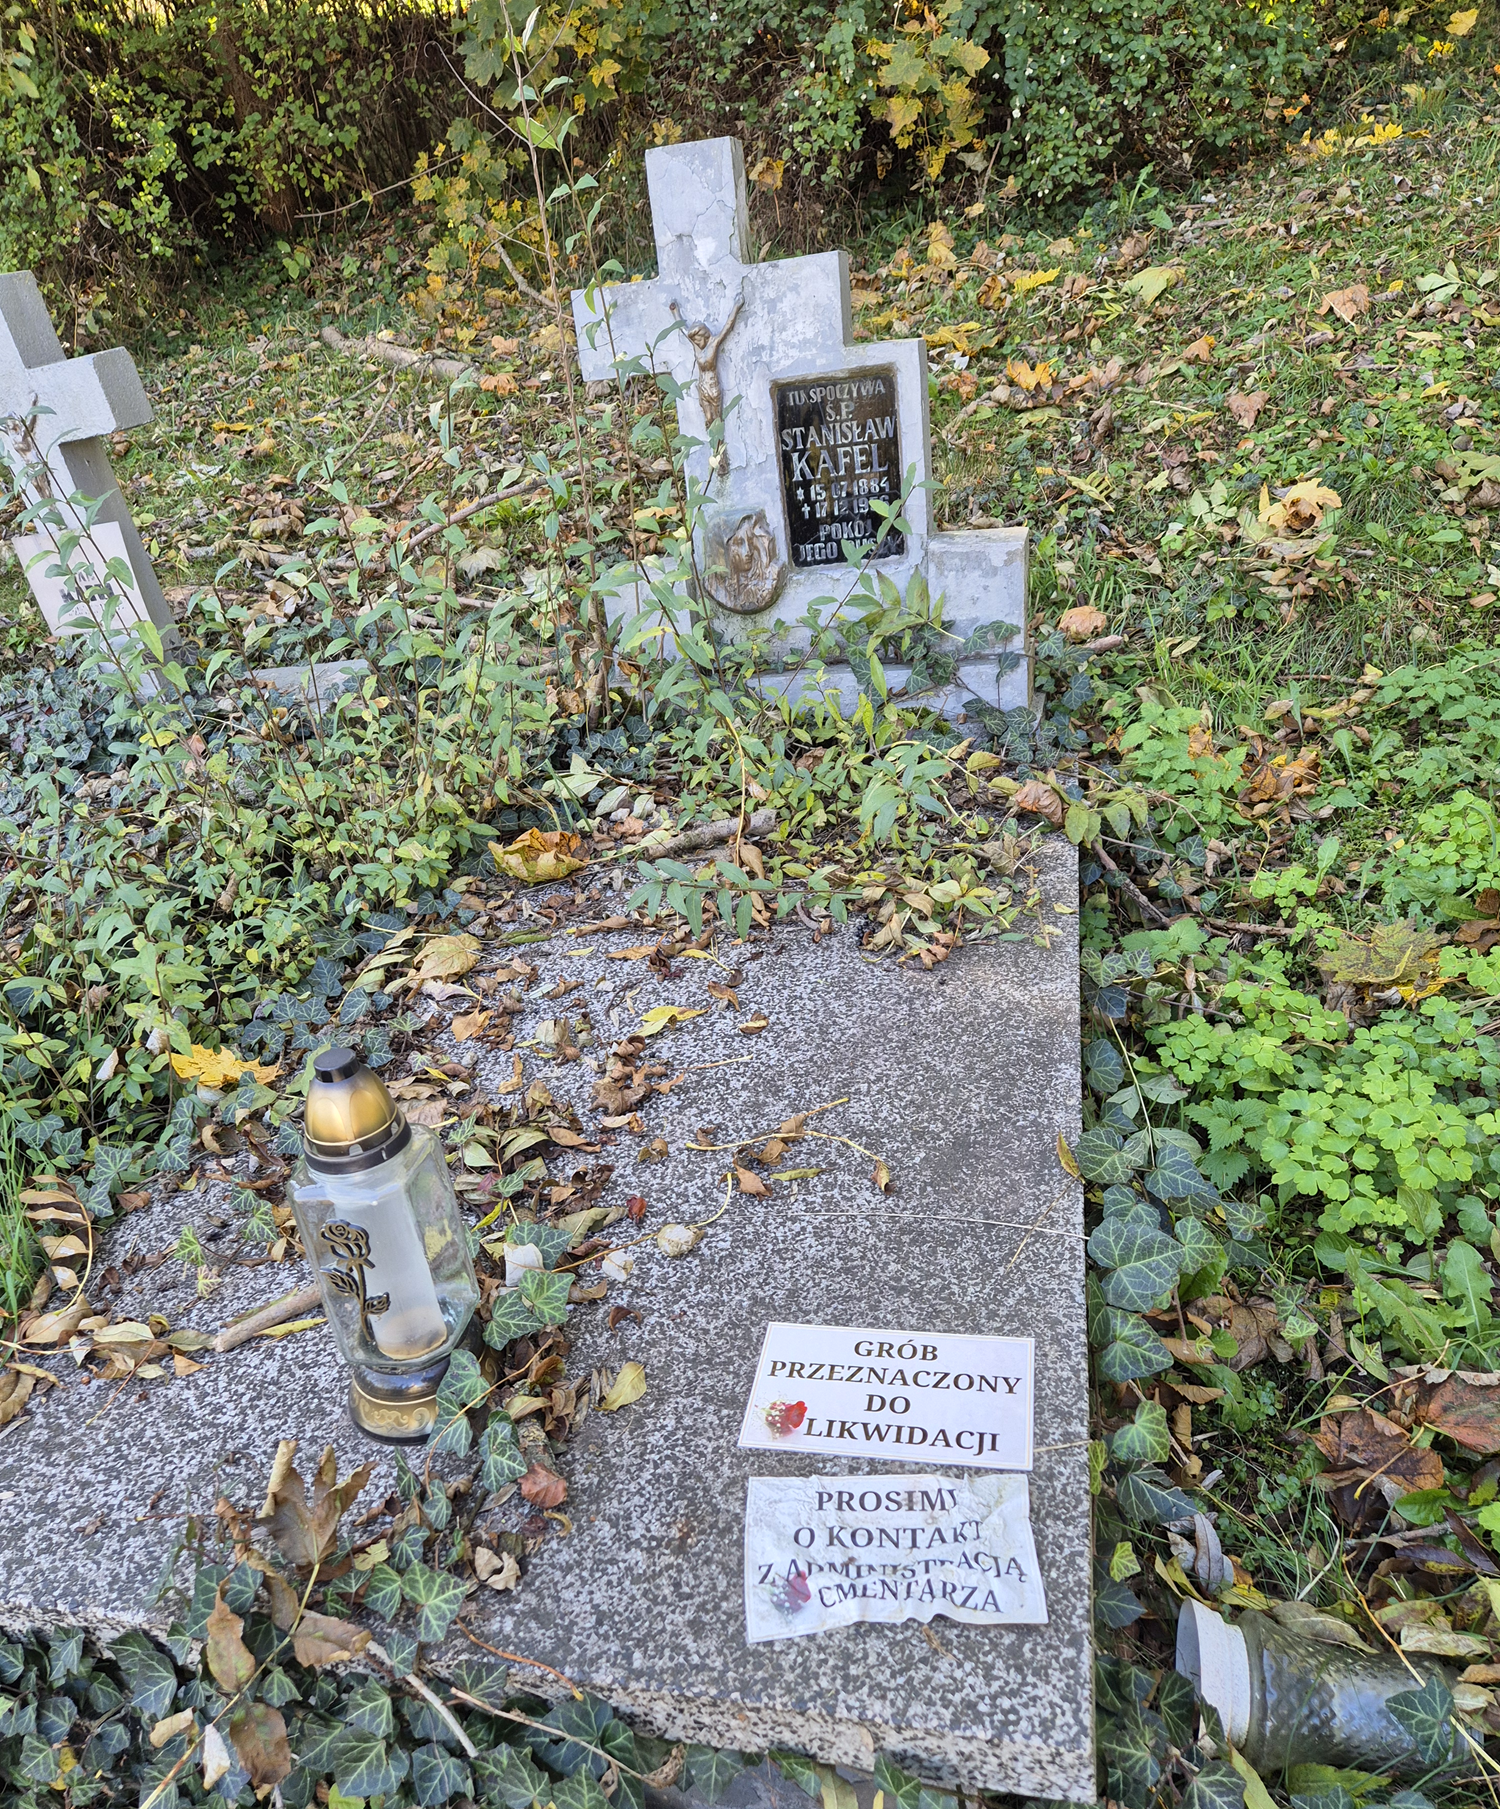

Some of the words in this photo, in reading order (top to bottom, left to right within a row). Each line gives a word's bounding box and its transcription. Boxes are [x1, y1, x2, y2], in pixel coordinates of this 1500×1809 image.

[810, 379, 886, 404] SPOCZYWA
[781, 416, 896, 450] STANISŁAW
[791, 443, 889, 482] KAFEL
[810, 484, 827, 501] 15
[831, 481, 848, 498] 07
[853, 476, 890, 496] 1884
[814, 501, 828, 518] 17
[799, 541, 838, 562] JEGO
[854, 1339, 939, 1361] GRÓB
[767, 1359, 1022, 1395] PRZEZNACZONY
[863, 1393, 911, 1415] DO
[803, 1417, 1001, 1457] LIKWIDACJI
[793, 1527, 816, 1549] O
[825, 1520, 984, 1549] KONTAKT
[758, 1563, 776, 1584] Z
[818, 1578, 1004, 1614] CMENTARZA
